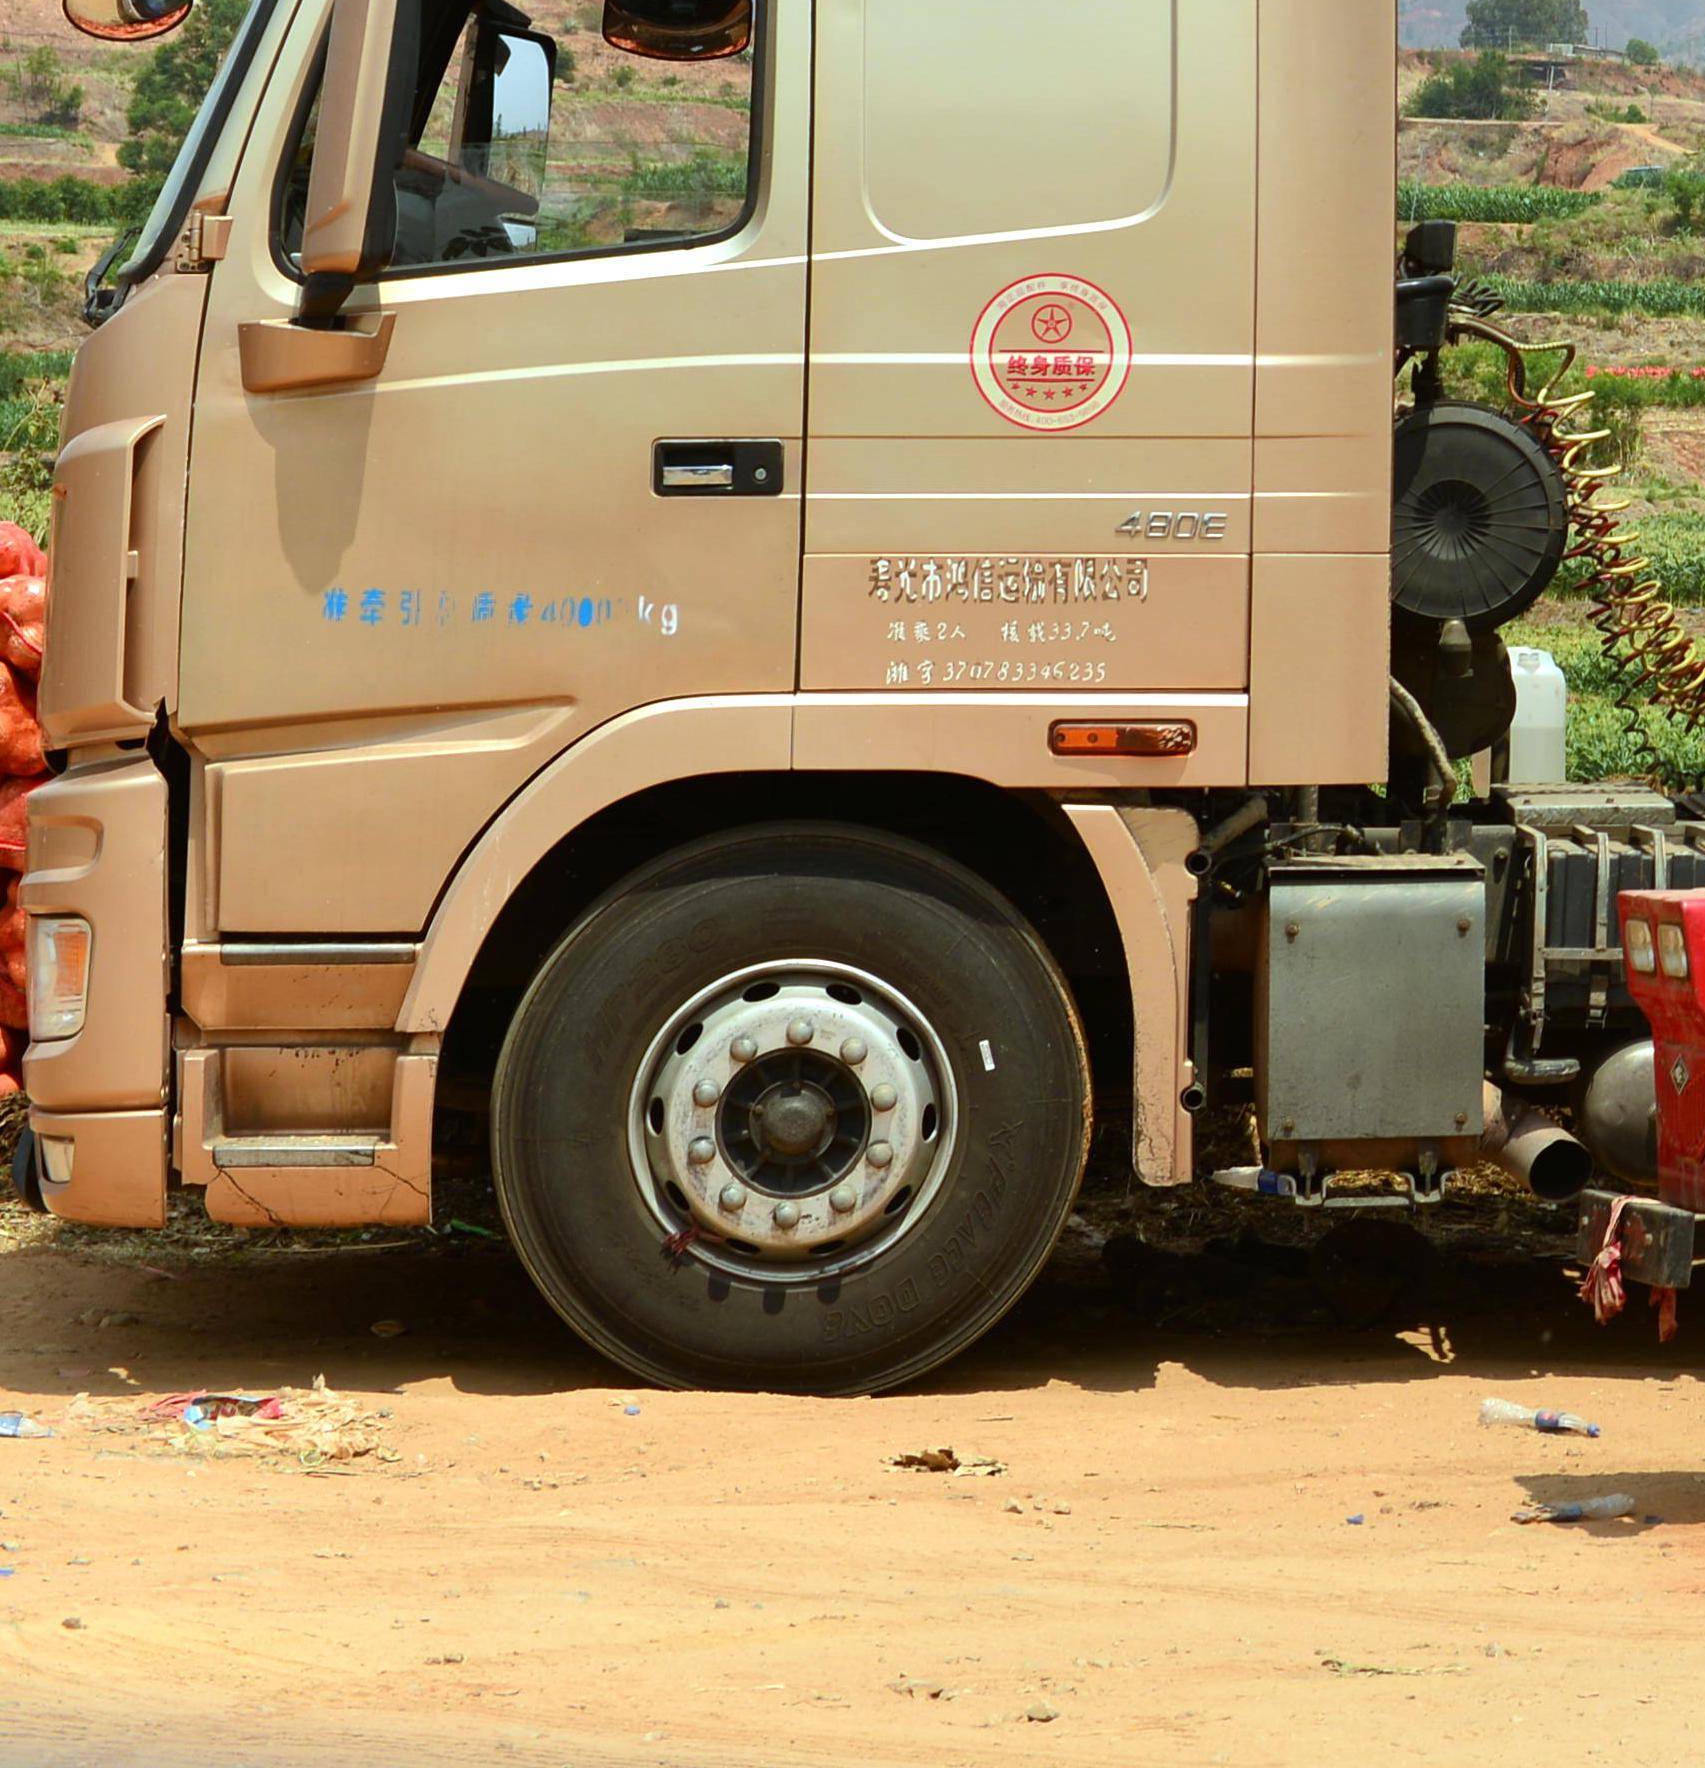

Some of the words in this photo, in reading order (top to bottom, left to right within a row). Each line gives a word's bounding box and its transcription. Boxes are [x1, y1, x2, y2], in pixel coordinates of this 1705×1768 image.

[1007, 354, 1096, 376] 终身质保
[1115, 511, 1228, 540] 480E
[637, 595, 678, 636] kg
